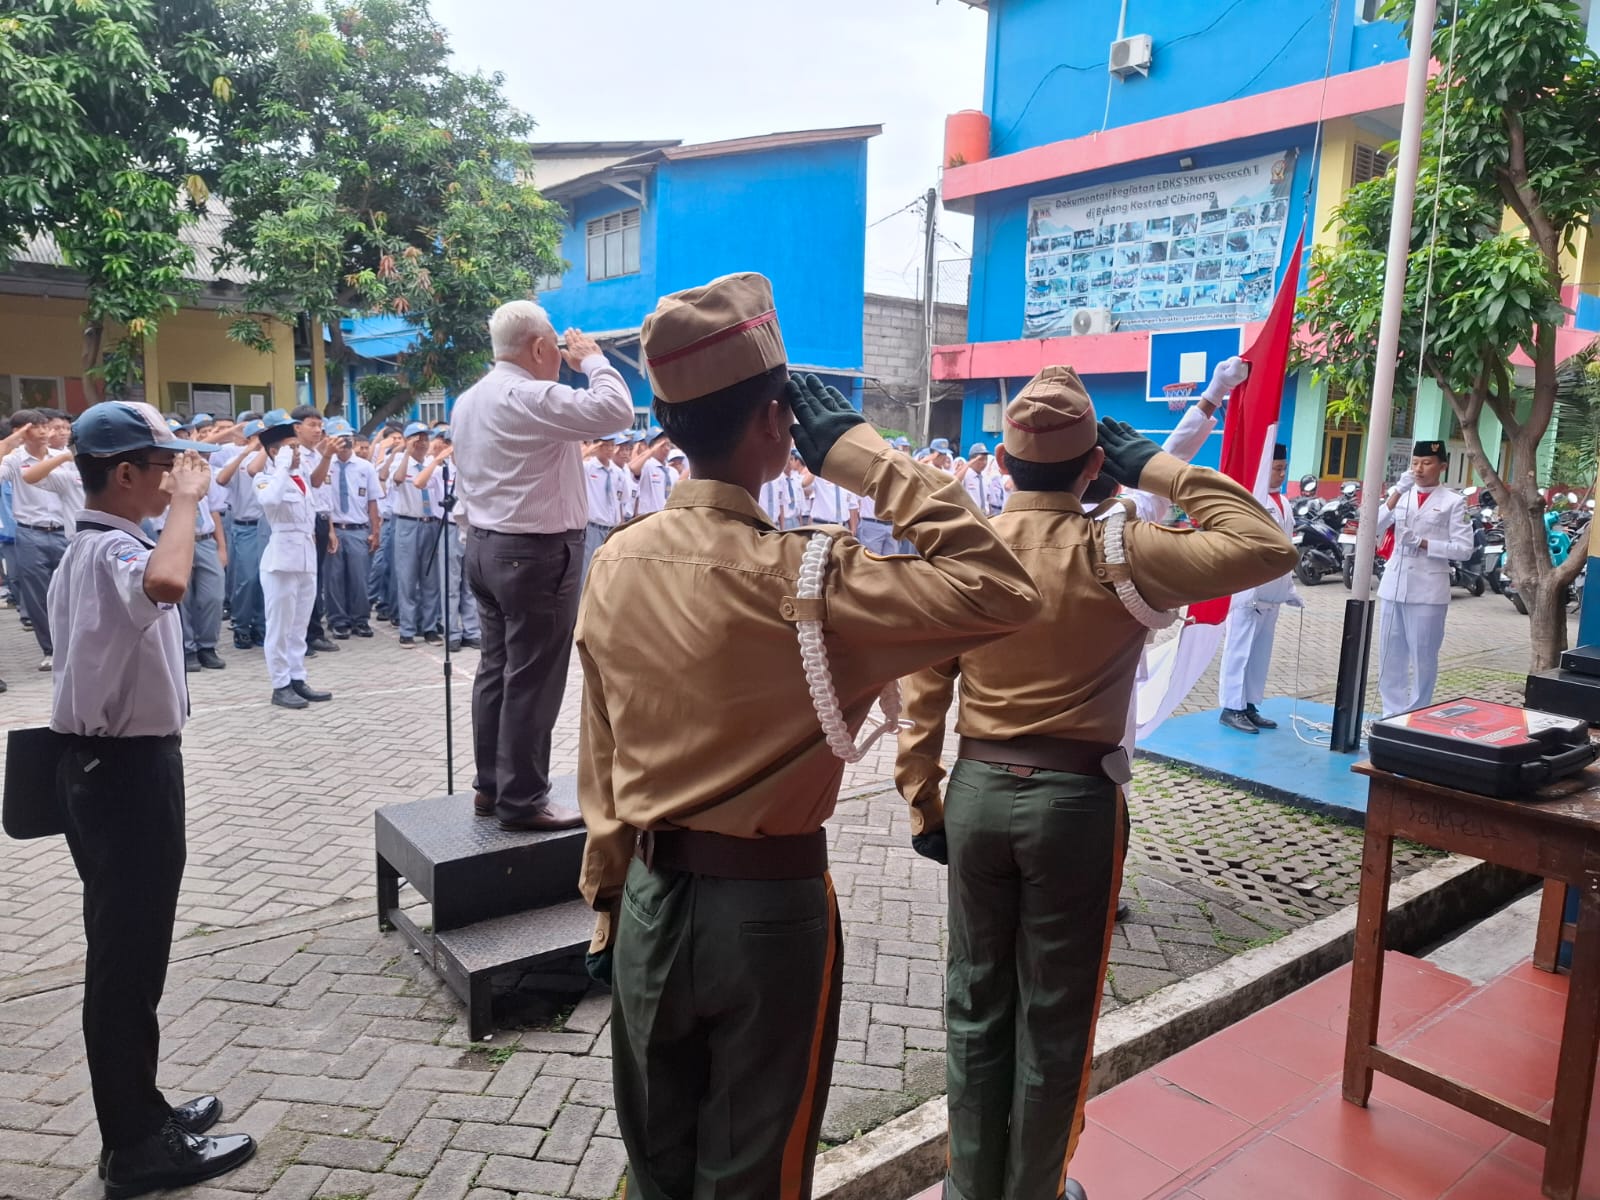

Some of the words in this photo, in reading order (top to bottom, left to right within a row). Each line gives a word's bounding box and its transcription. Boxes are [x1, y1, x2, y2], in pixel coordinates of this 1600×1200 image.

[1056, 190, 1111, 208] Dokumentasi
[1157, 177, 1181, 190] LDKS
[1086, 207, 1096, 219] di
[1130, 195, 1168, 211] Kostrad
[1170, 191, 1216, 204] Cibinong
